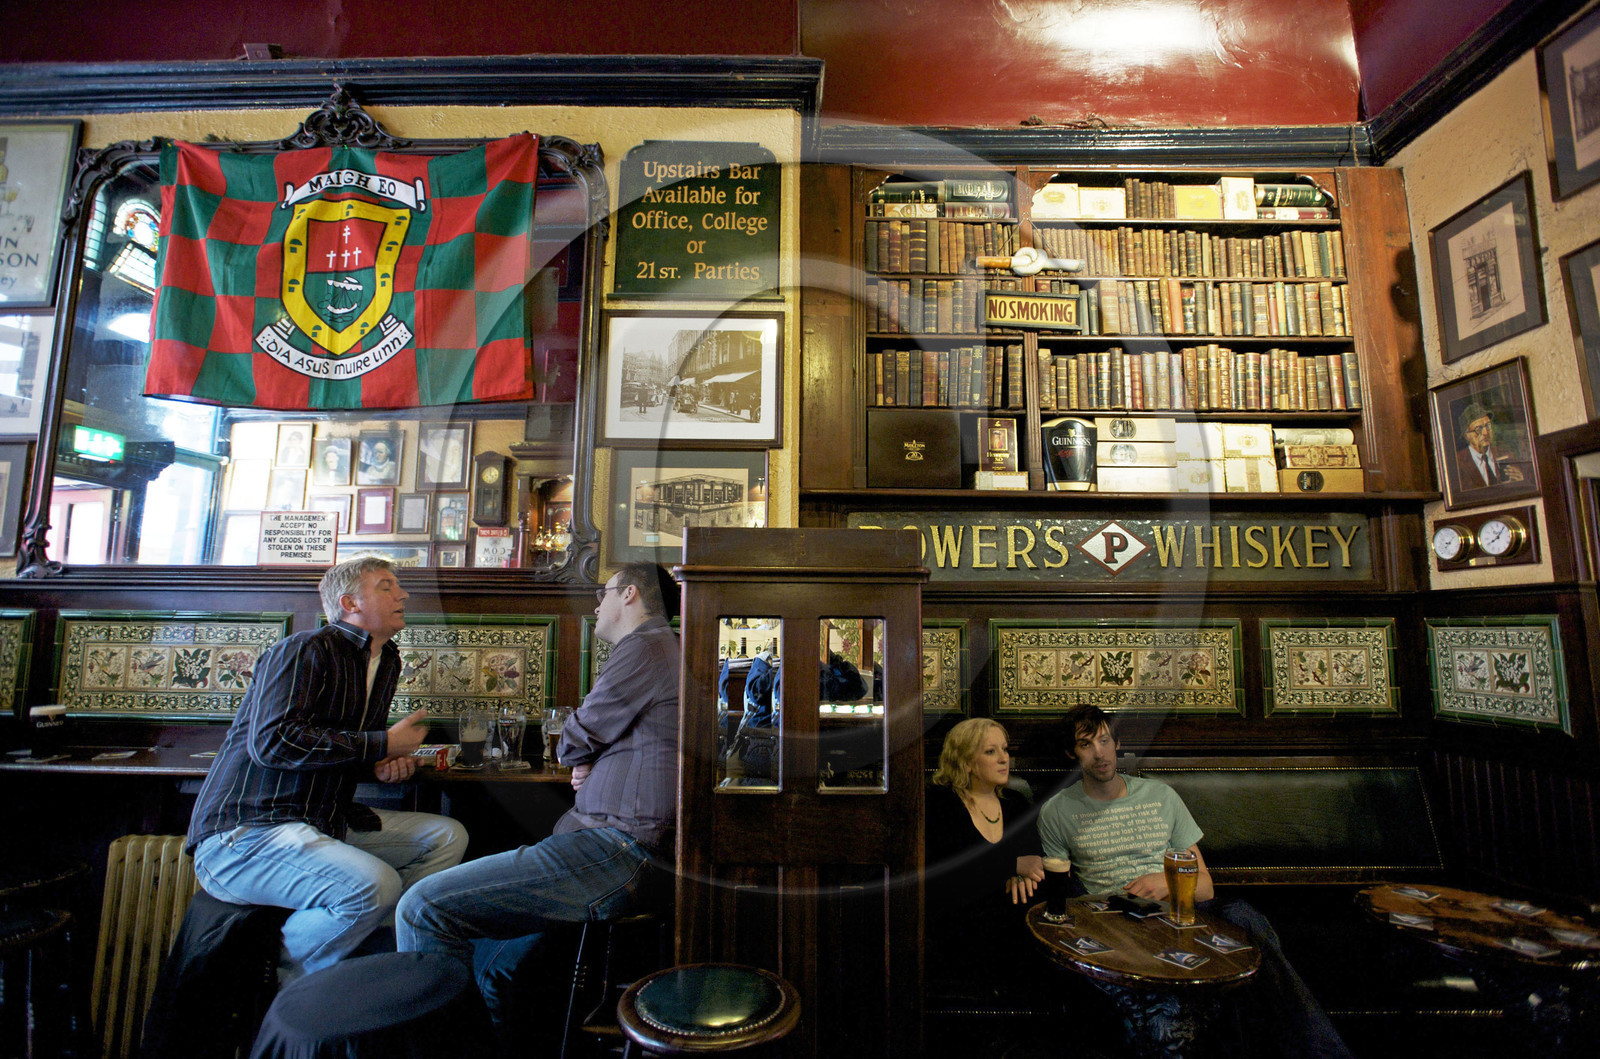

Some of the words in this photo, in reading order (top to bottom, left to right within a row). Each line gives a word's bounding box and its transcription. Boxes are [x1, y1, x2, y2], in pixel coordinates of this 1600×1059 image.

[643, 161, 720, 182] Upstairs
[729, 163, 761, 179] Bar
[309, 172, 370, 193] MAIGH
[378, 179, 396, 196] EO
[641, 186, 727, 204] Available
[735, 186, 760, 205] for
[632, 211, 693, 232] Office,
[702, 212, 768, 235] College
[686, 240, 707, 254] or
[694, 262, 760, 280] Parties
[988, 299, 1007, 319] NO
[1009, 301, 1073, 322] SMOKING
[1103, 532, 1129, 563] P
[1153, 525, 1359, 568] WHISKEY
